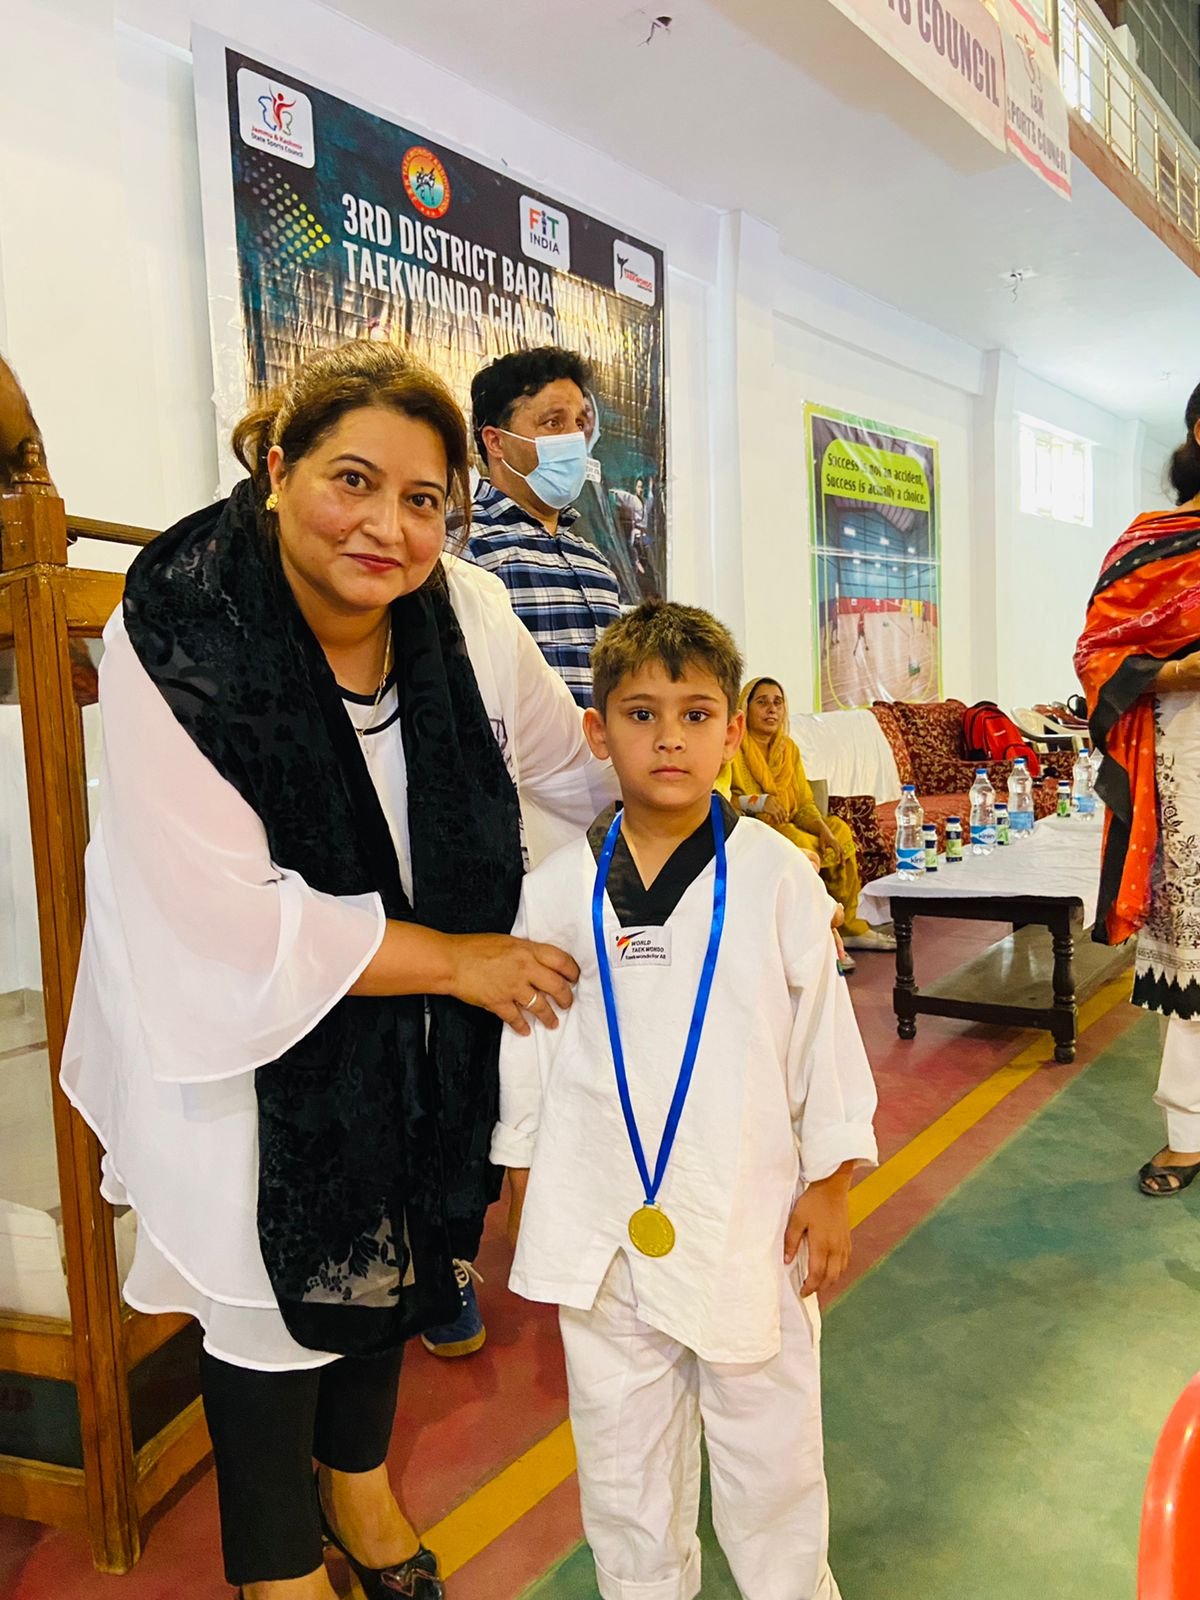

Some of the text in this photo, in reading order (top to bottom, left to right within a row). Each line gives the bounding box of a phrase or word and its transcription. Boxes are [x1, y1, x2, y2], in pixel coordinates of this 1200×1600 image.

[917, 0, 1000, 108] COUNCIL
[1037, 127, 1068, 175] COUNCIL
[342, 193, 393, 247] 3RD
[399, 214, 497, 286] DISTRICT
[530, 232, 560, 256] INDIA
[342, 240, 482, 321] TAEKWONDO
[826, 473, 857, 492] Success
[858, 480, 866, 494] is
